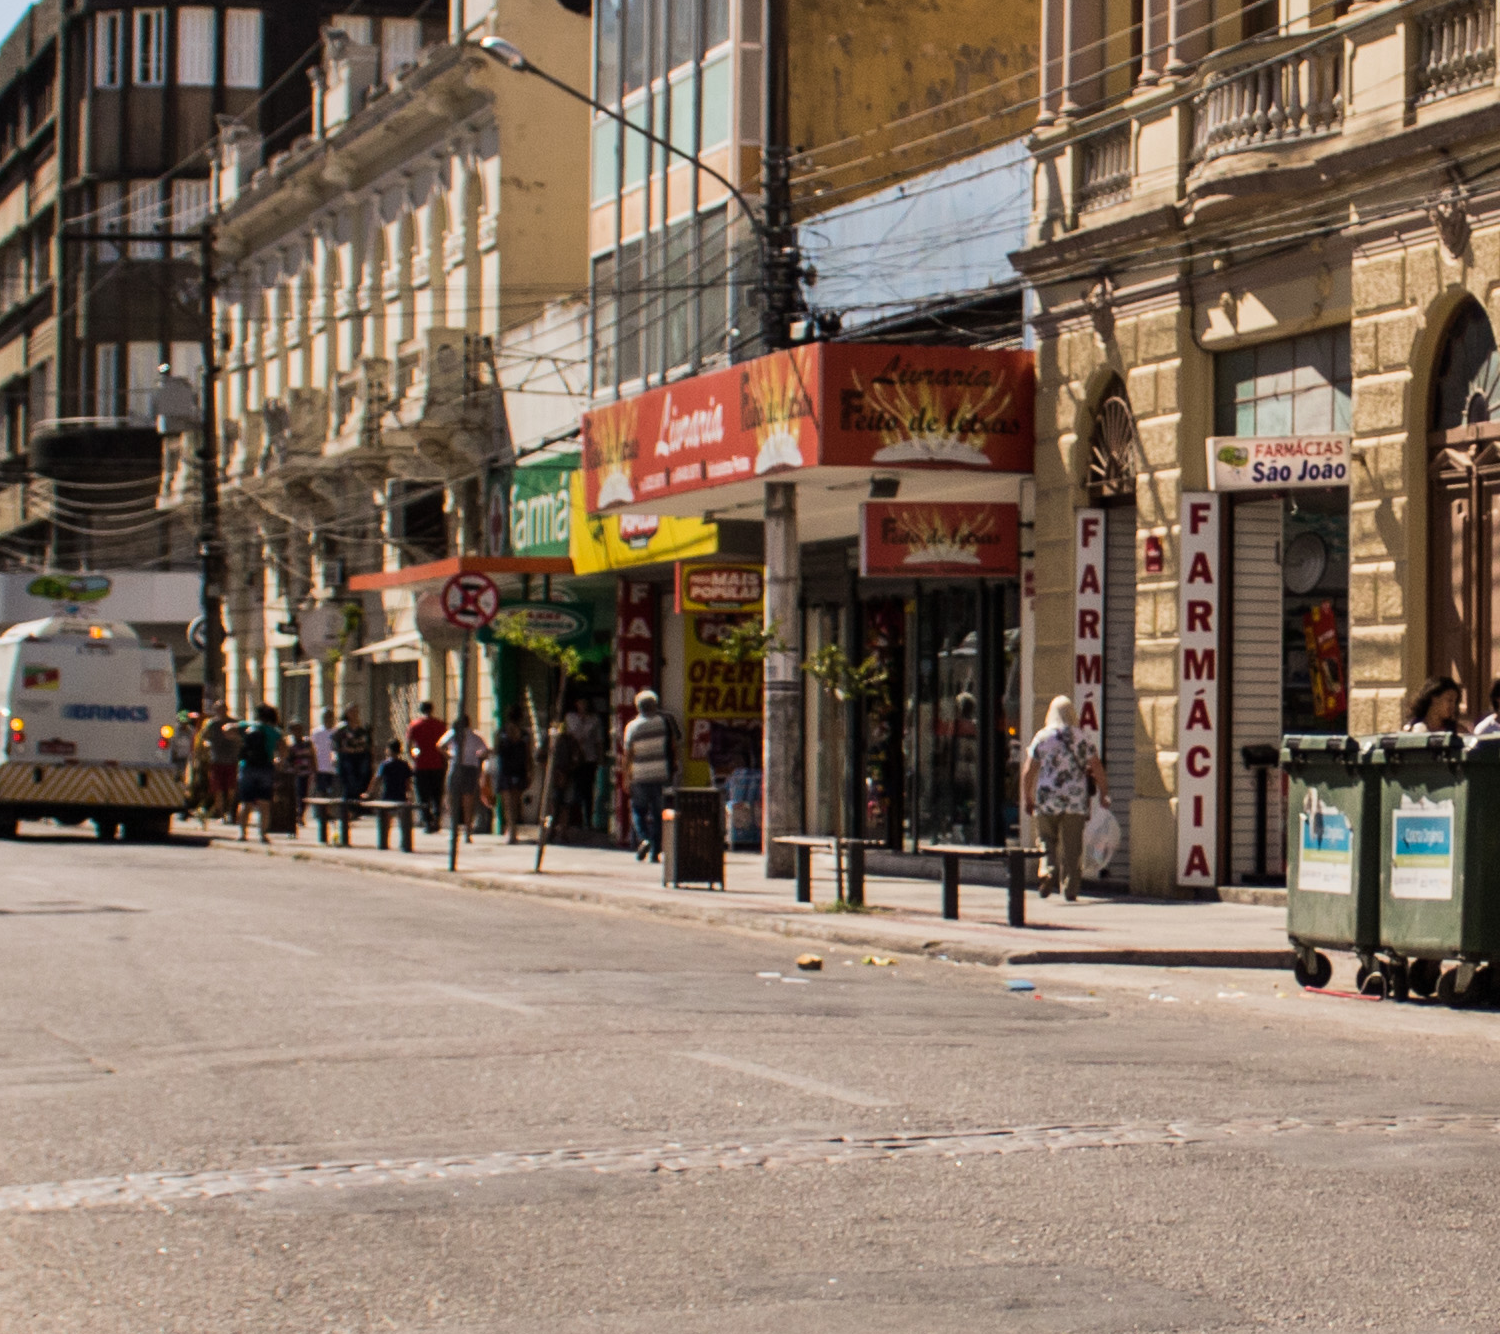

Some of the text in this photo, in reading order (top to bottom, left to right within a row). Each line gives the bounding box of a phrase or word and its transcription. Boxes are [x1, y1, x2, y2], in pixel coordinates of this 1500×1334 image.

[871, 354, 993, 388] Livraria
[655, 391, 724, 457] Livraria
[841, 388, 1021, 435] Feito de letras
[1255, 441, 1344, 460] FARMÁCIAS
[1252, 455, 1347, 485] São João
[690, 586, 760, 600] POPULAR
[1183, 503, 1217, 880] FARMÁCIA
